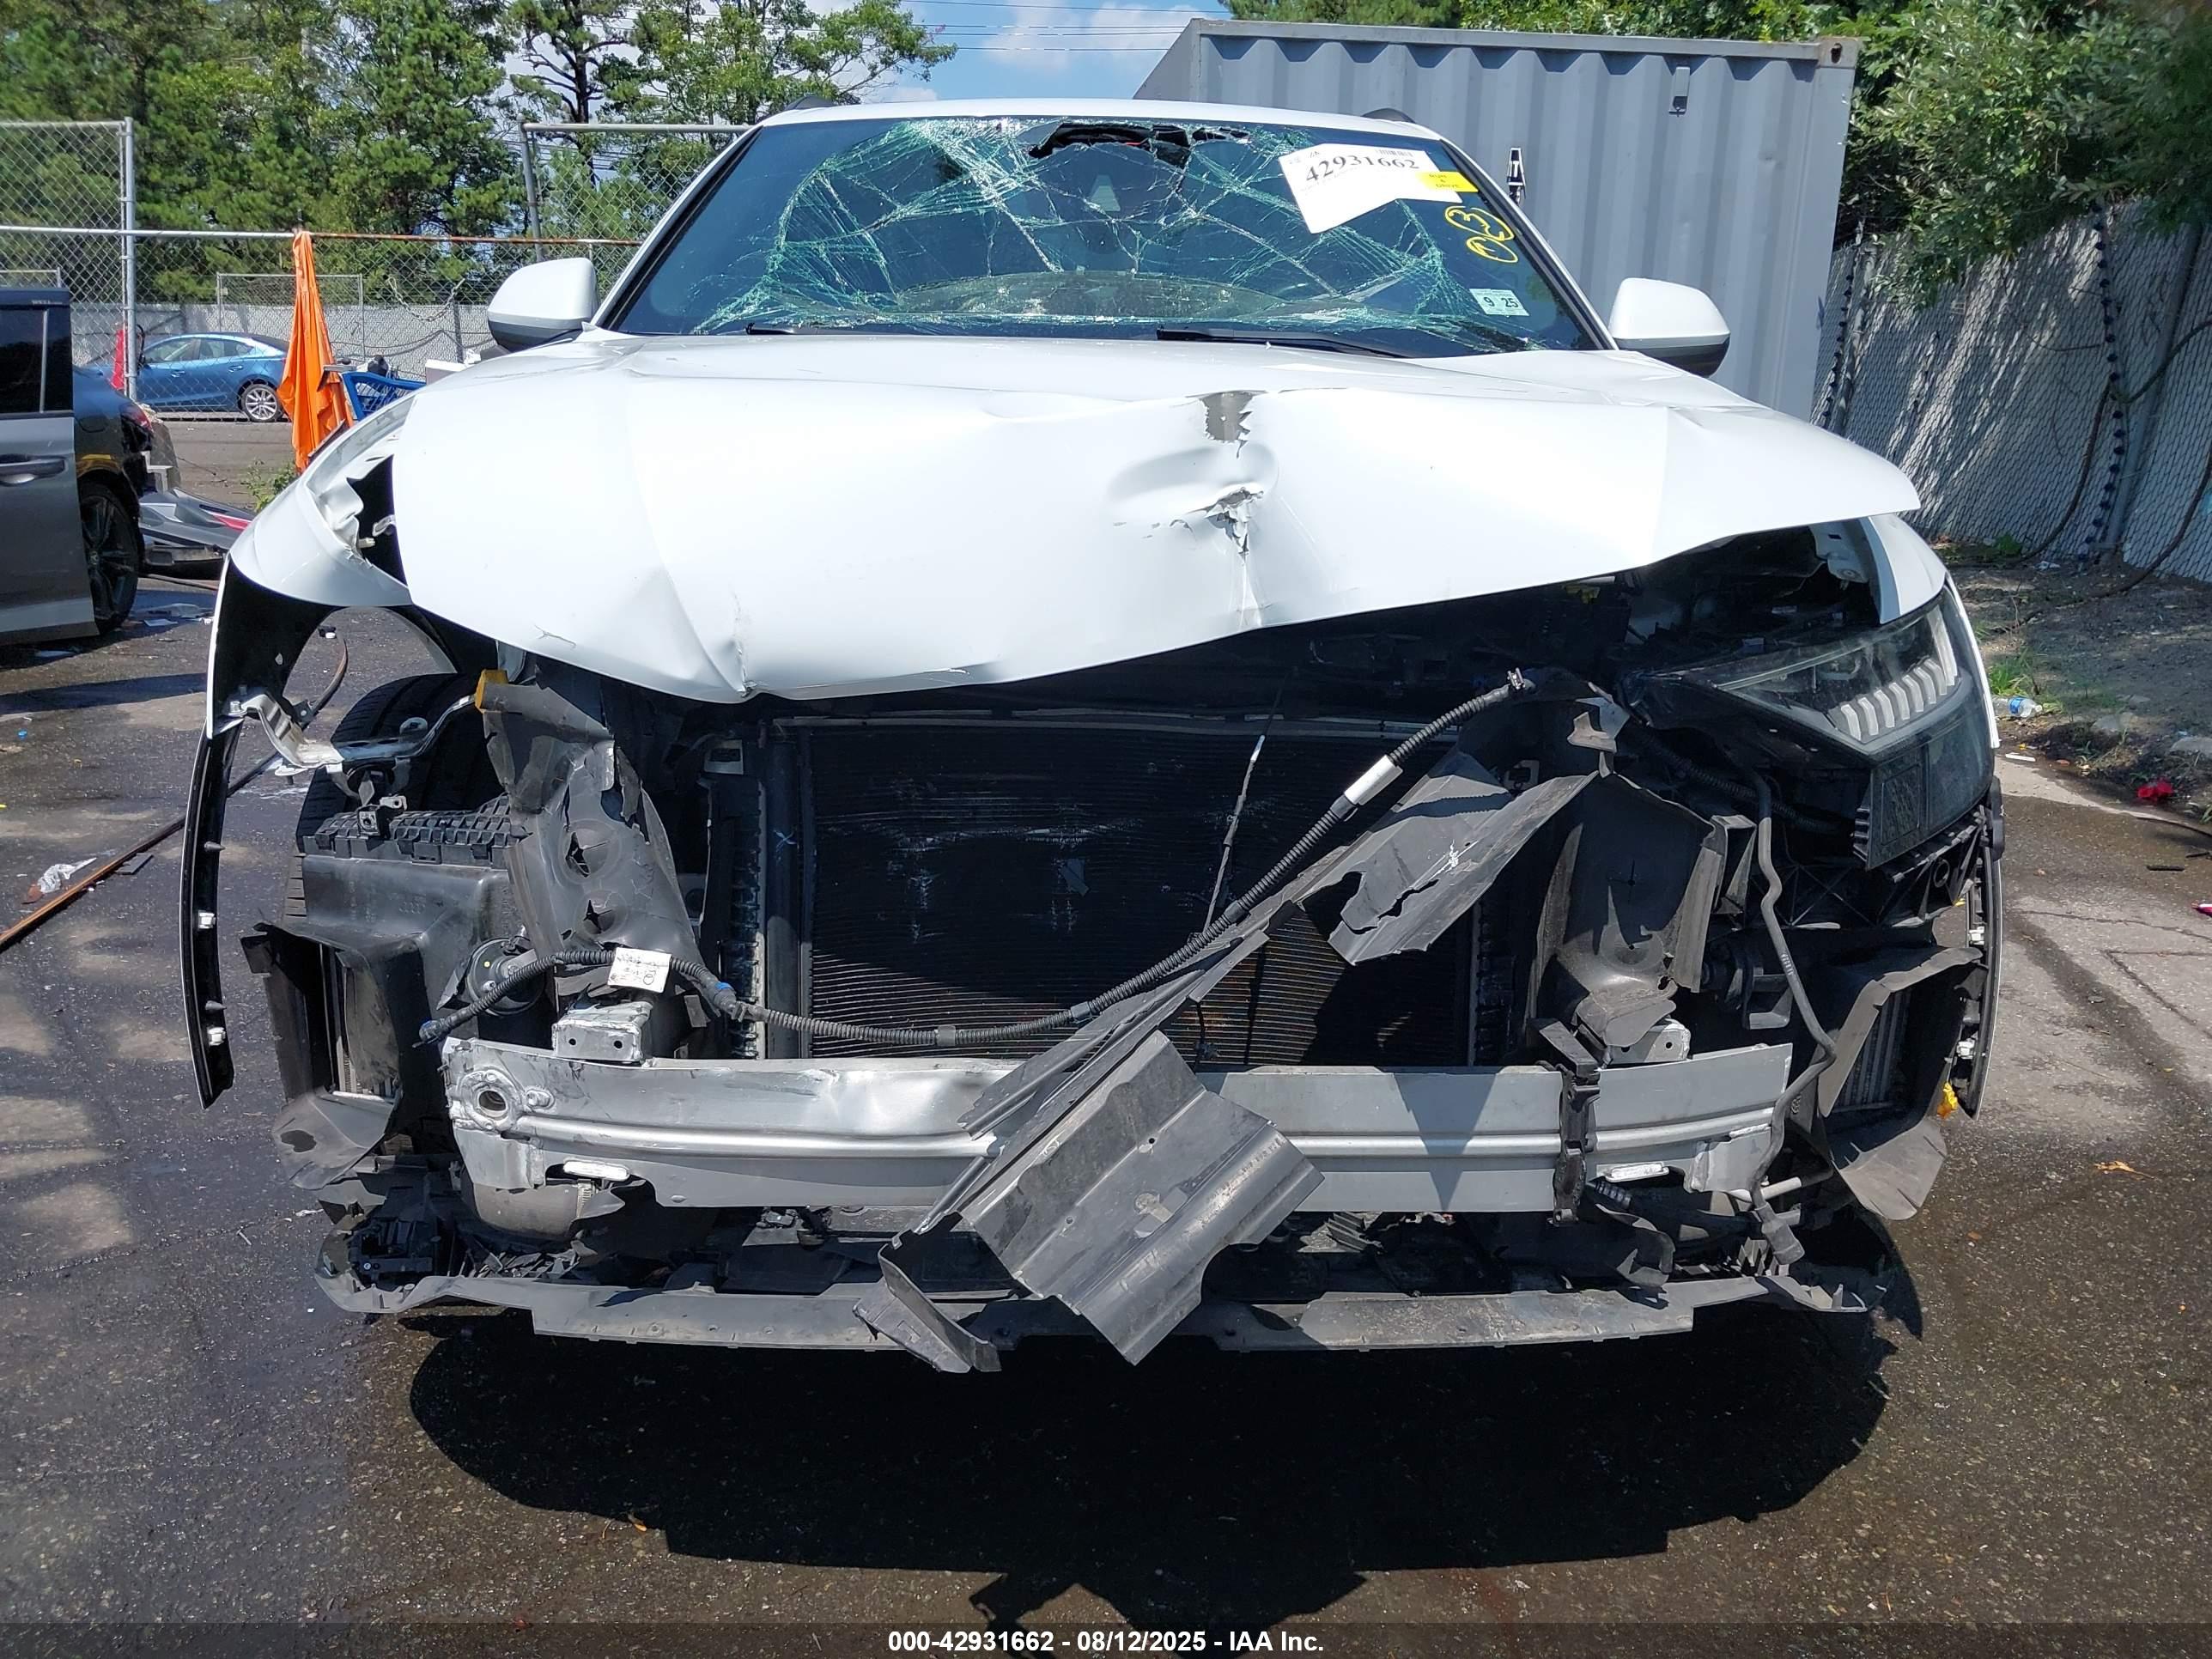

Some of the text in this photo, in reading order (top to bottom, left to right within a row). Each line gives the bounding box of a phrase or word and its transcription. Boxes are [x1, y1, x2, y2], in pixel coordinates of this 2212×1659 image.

[1306, 155, 1419, 181] 42931662
[1483, 296, 1519, 308] 9 25
